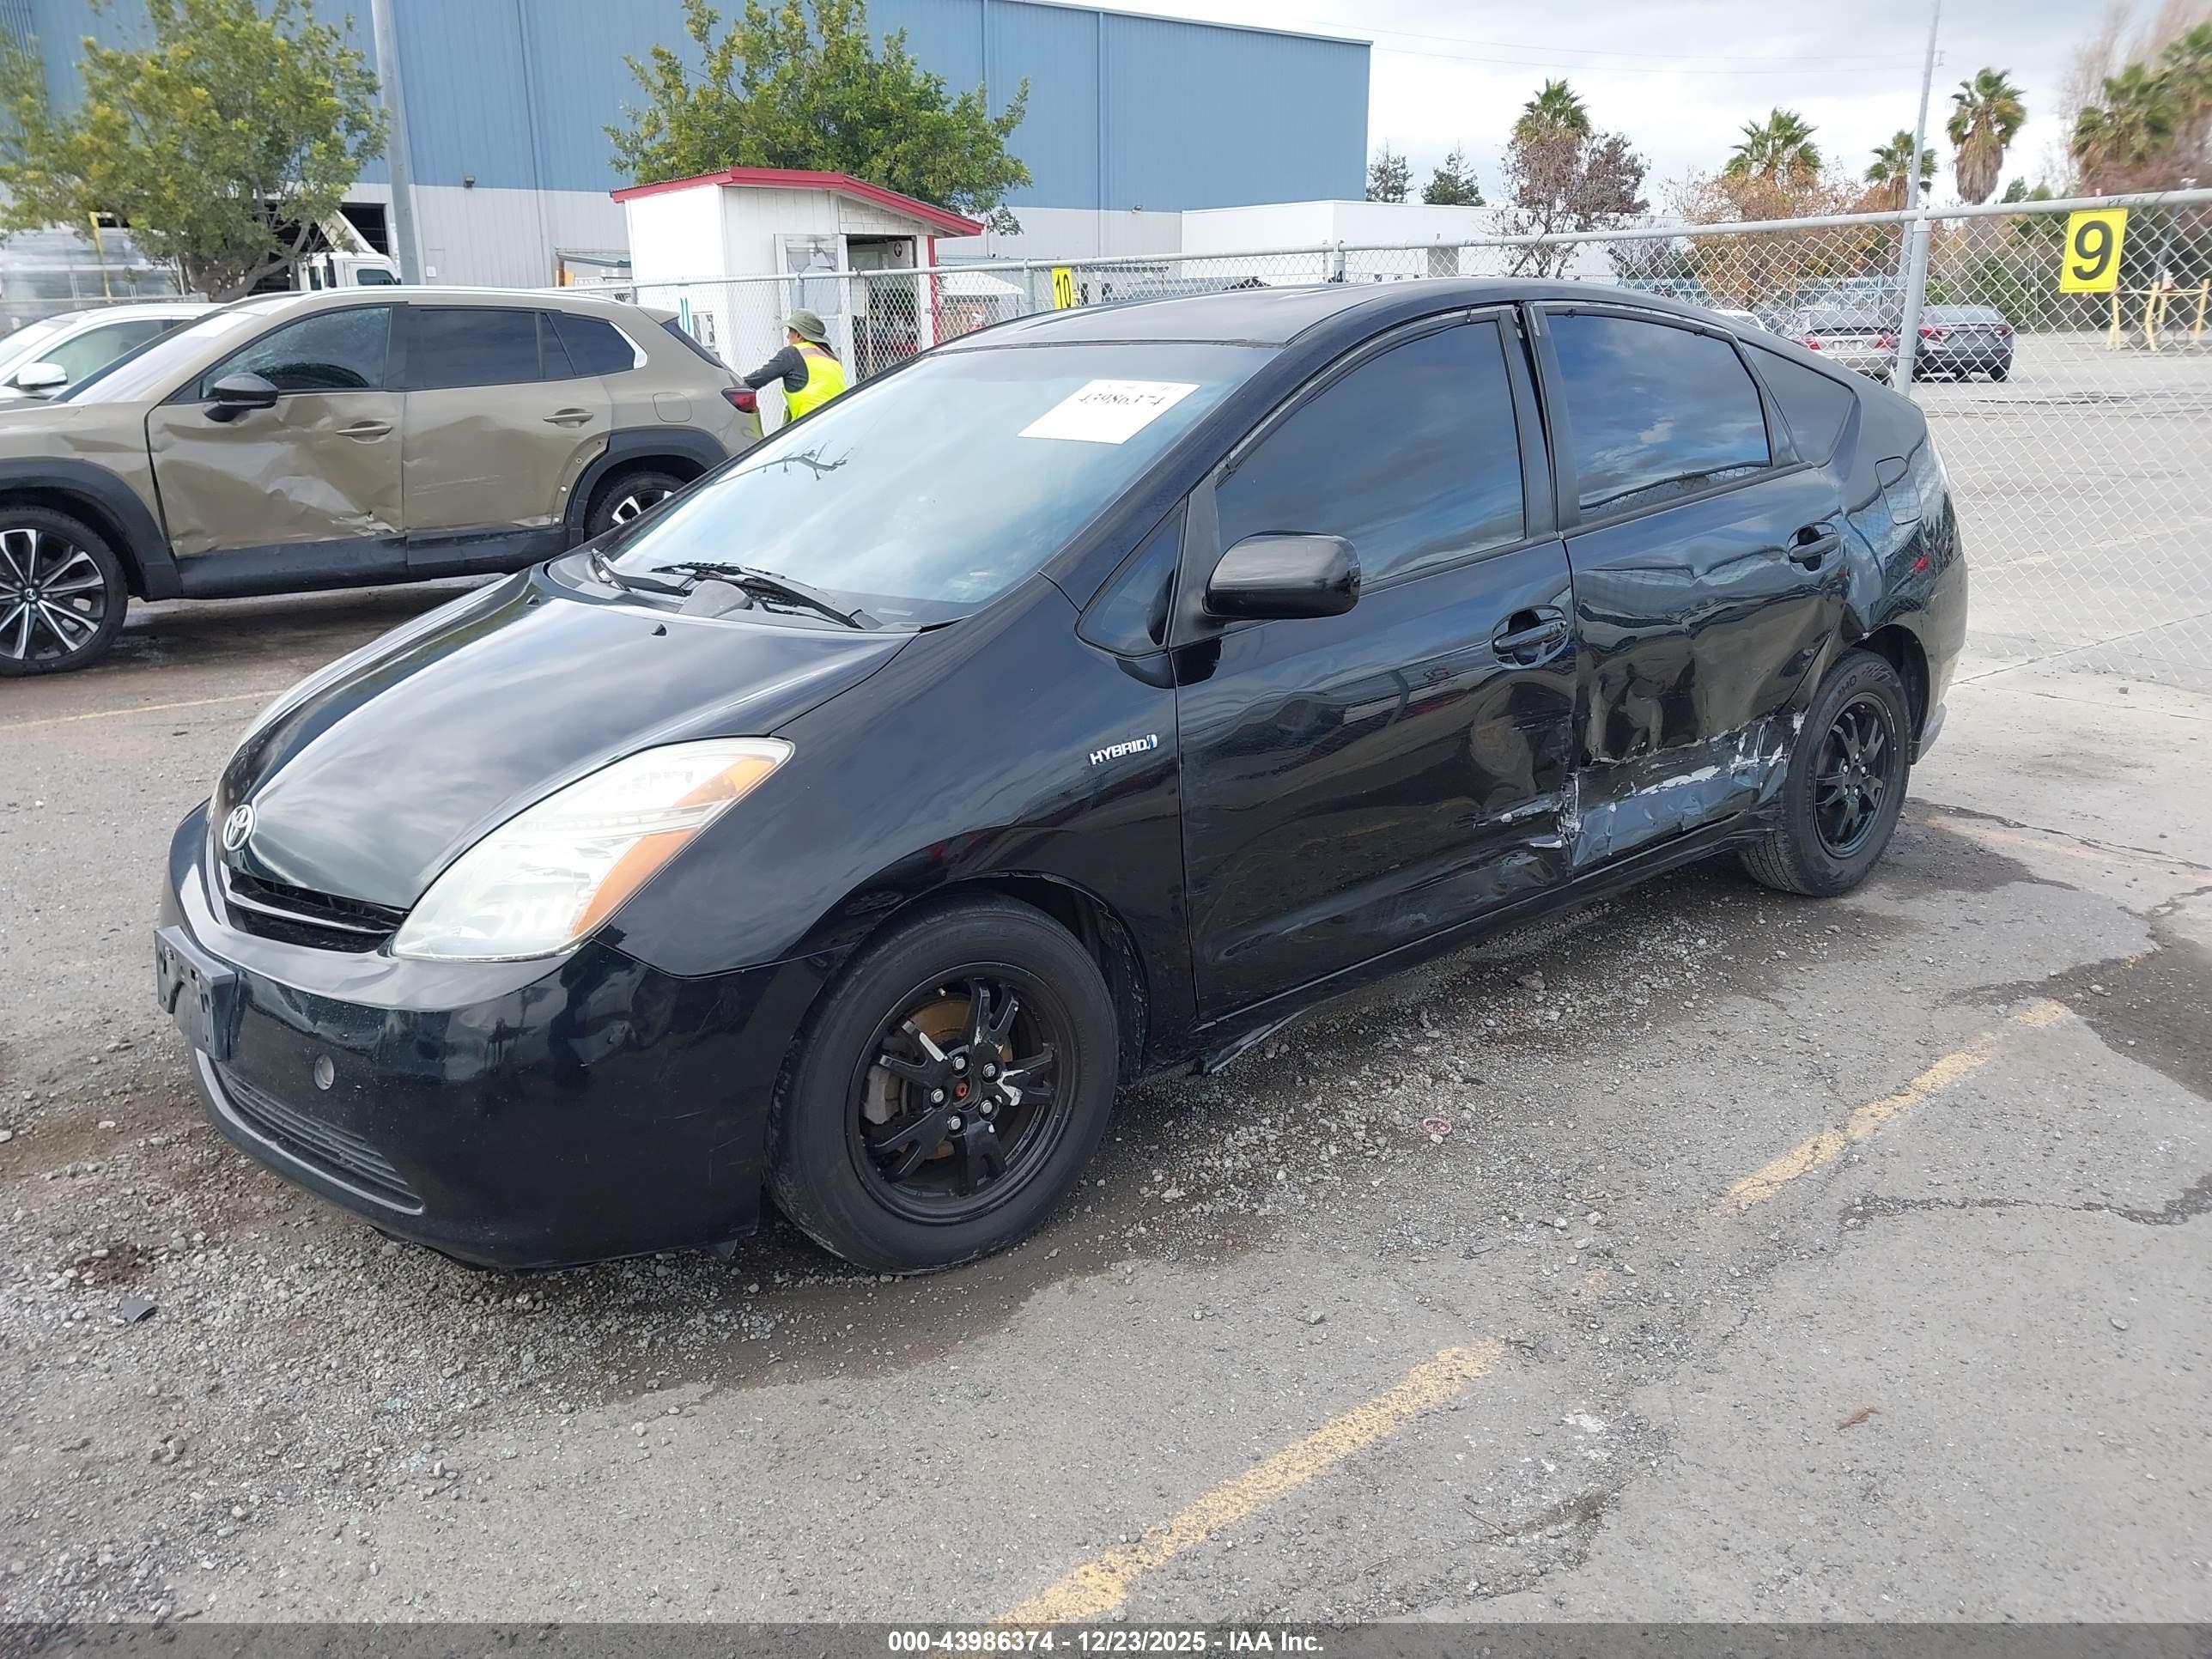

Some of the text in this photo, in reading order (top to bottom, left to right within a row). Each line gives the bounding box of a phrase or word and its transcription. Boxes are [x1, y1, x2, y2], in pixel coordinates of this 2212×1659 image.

[2072, 220, 2113, 281] 9
[1055, 273, 1072, 308] 10
[1089, 738, 1150, 765] HYBRID
